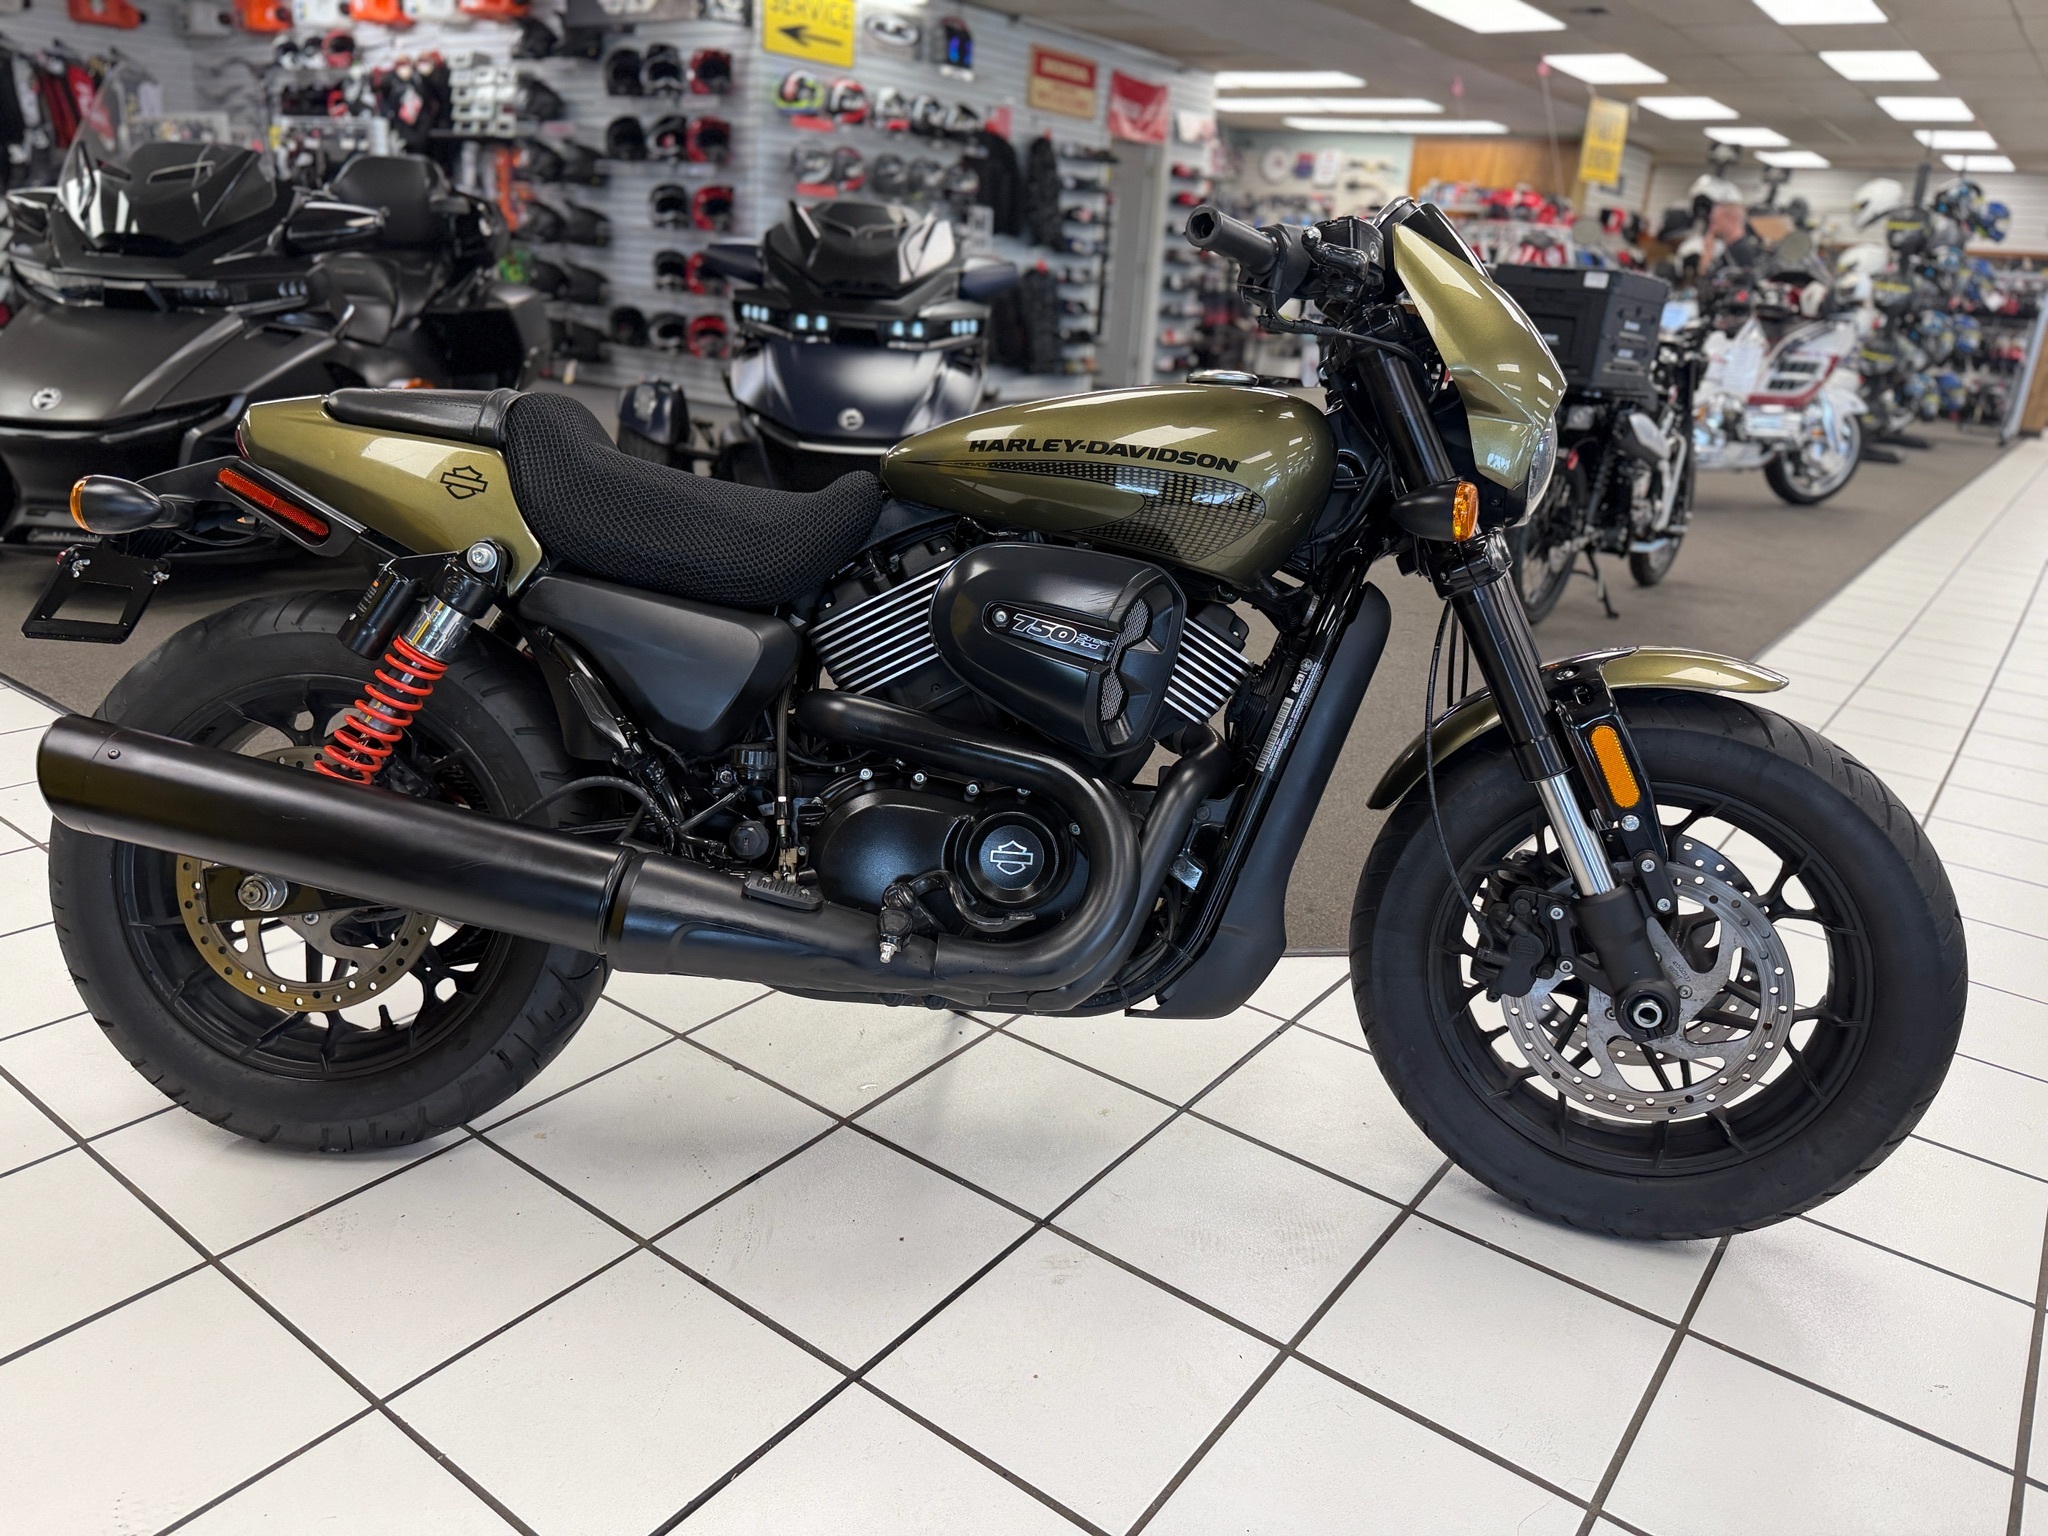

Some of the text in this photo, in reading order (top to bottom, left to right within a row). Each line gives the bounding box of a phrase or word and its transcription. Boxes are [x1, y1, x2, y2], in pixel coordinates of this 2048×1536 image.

[768, 0, 850, 30] SERVICE
[968, 438, 1240, 473] HARLEY-DAVIDSON
[1012, 613, 1078, 645] 750
[1074, 638, 1100, 650] Rod
